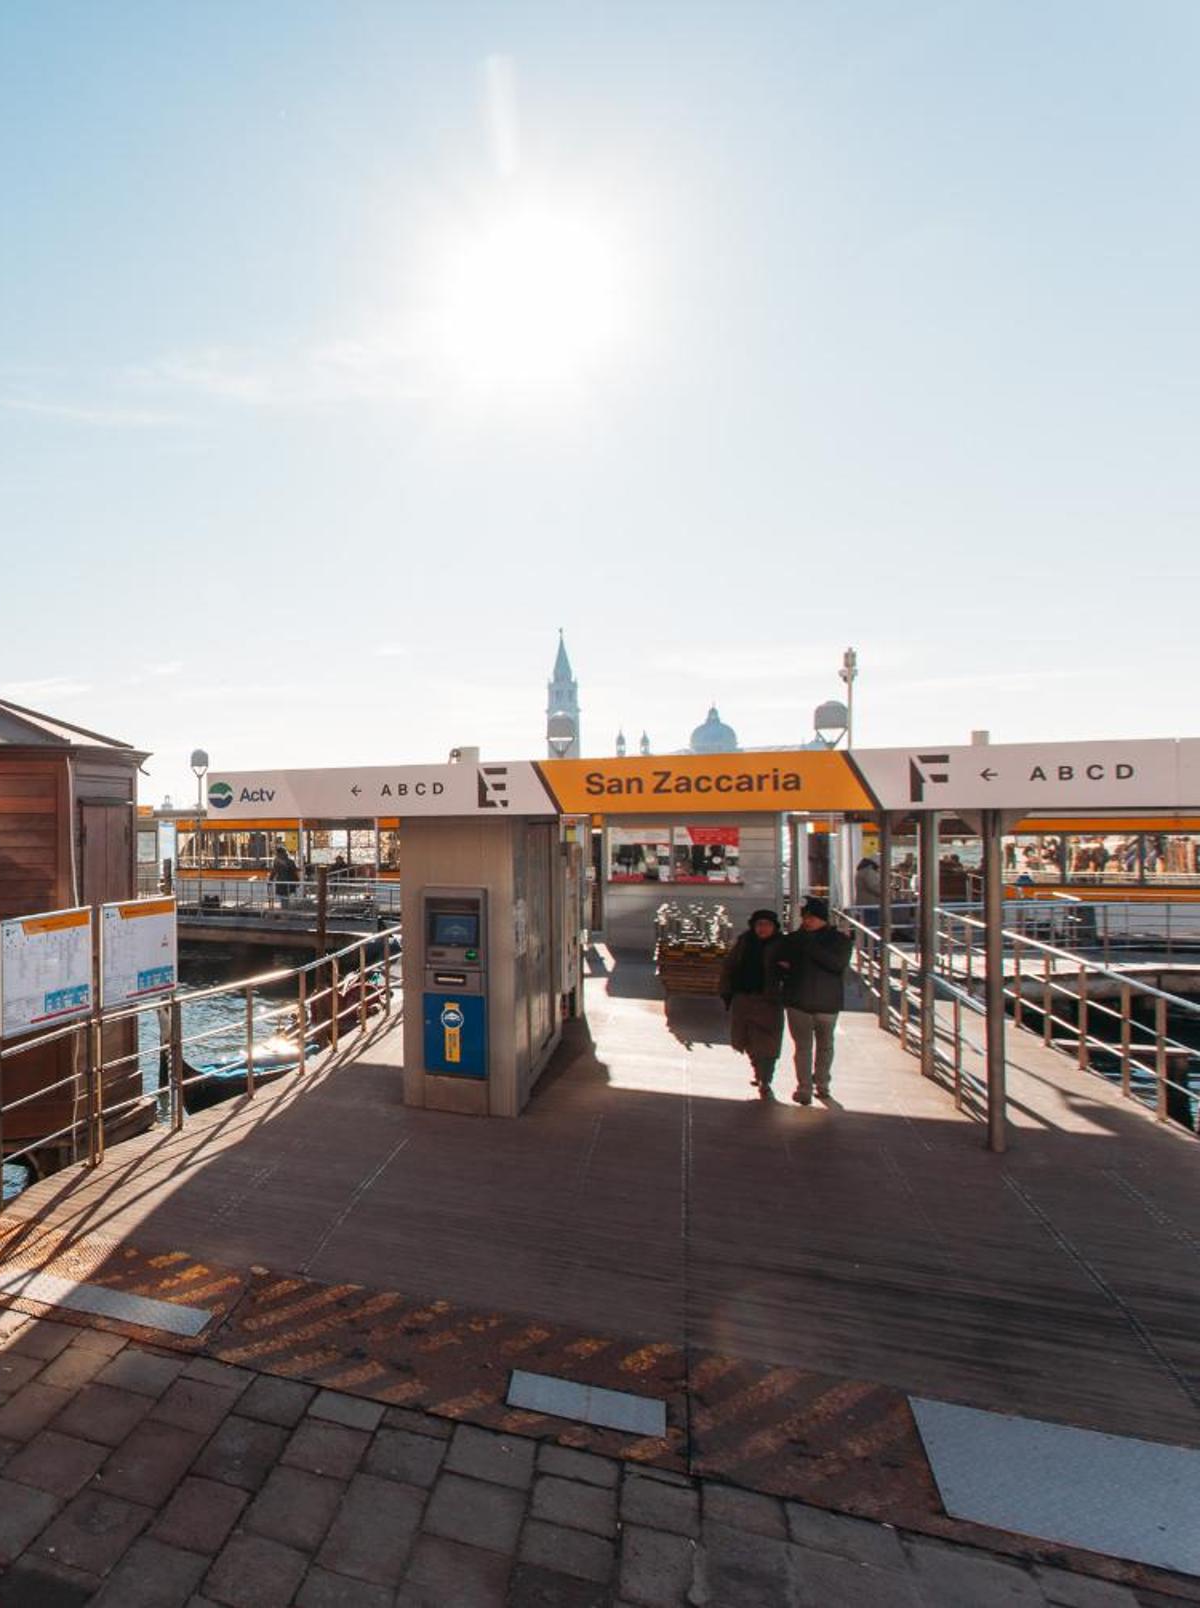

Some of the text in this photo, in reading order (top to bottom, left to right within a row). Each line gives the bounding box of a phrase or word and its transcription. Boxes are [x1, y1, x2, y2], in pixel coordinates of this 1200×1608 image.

[239, 787, 276, 803] Actv
[477, 767, 508, 808] E
[585, 768, 802, 795] San Zaccaria
[909, 754, 950, 802] F
